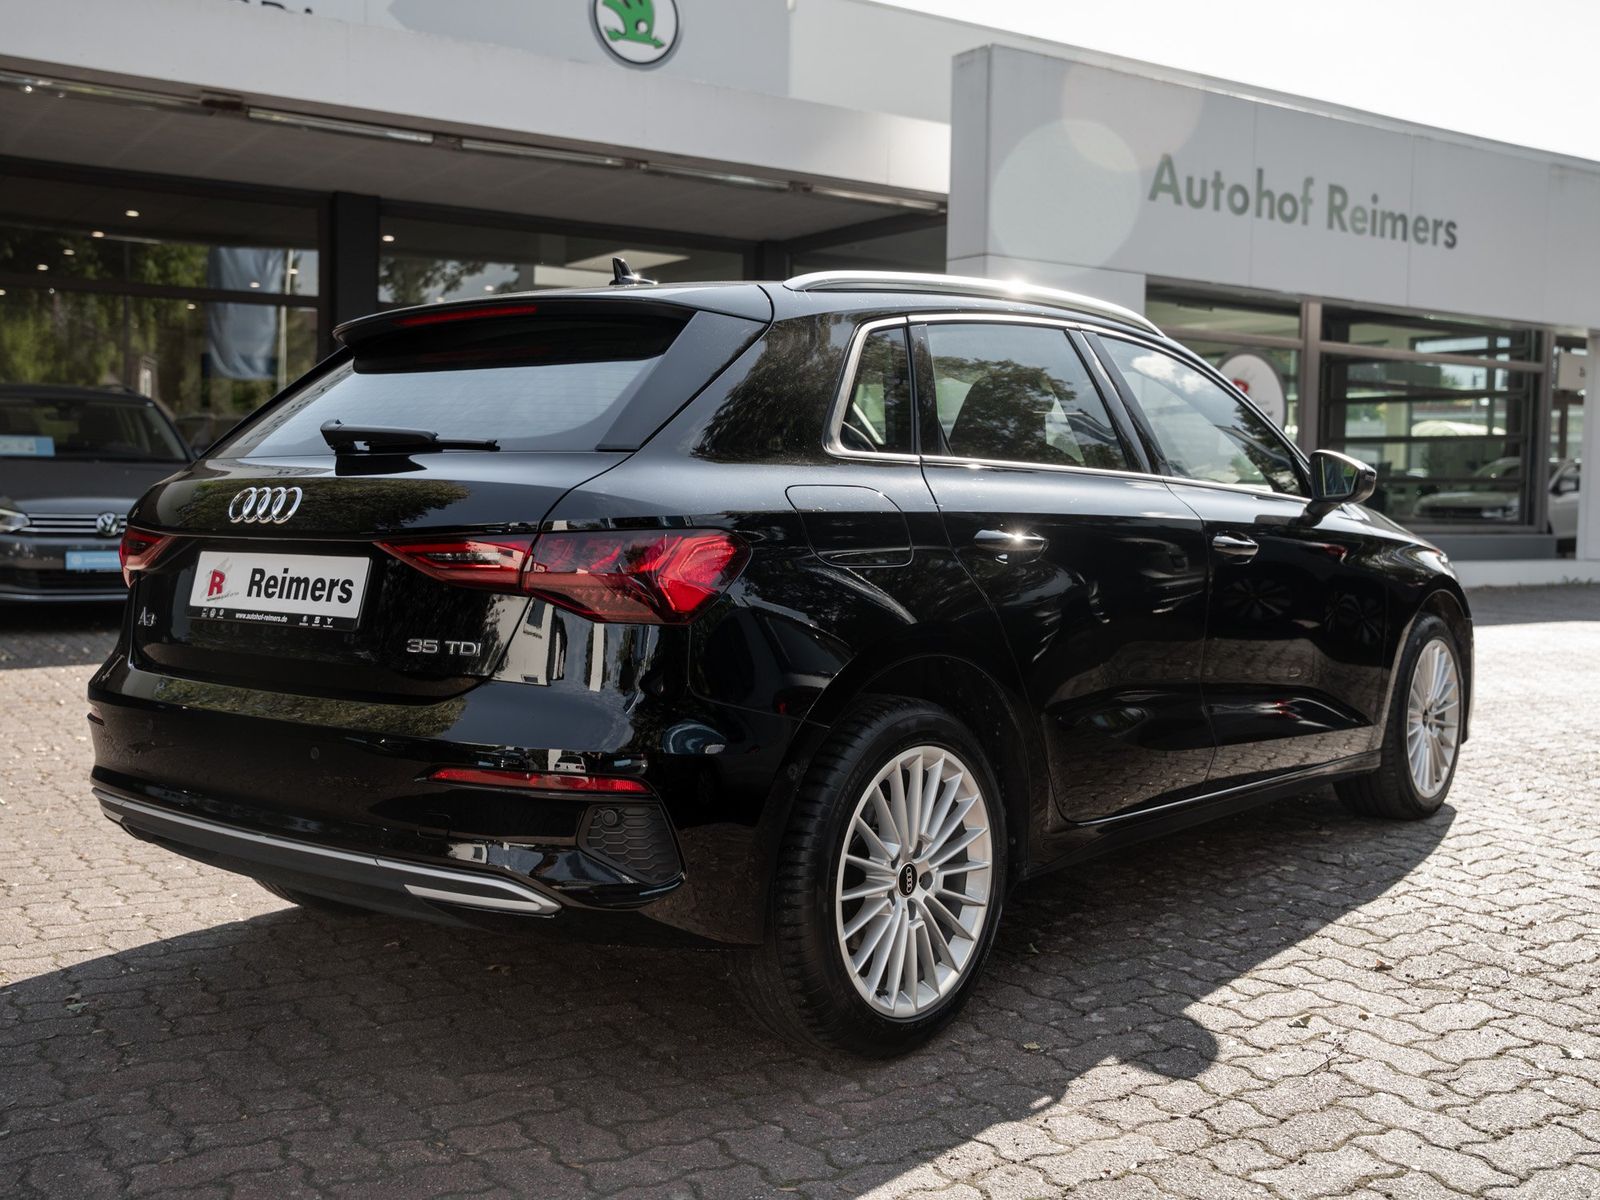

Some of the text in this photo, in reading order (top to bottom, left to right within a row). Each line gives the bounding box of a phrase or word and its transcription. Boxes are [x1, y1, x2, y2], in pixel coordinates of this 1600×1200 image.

[1148, 153, 1458, 250] Autohof Reimers
[246, 567, 355, 604] Reimers
[137, 606, 155, 627] A3
[235, 612, 288, 624] www.autohof-reimers.de
[406, 638, 482, 657] 35 TDI
